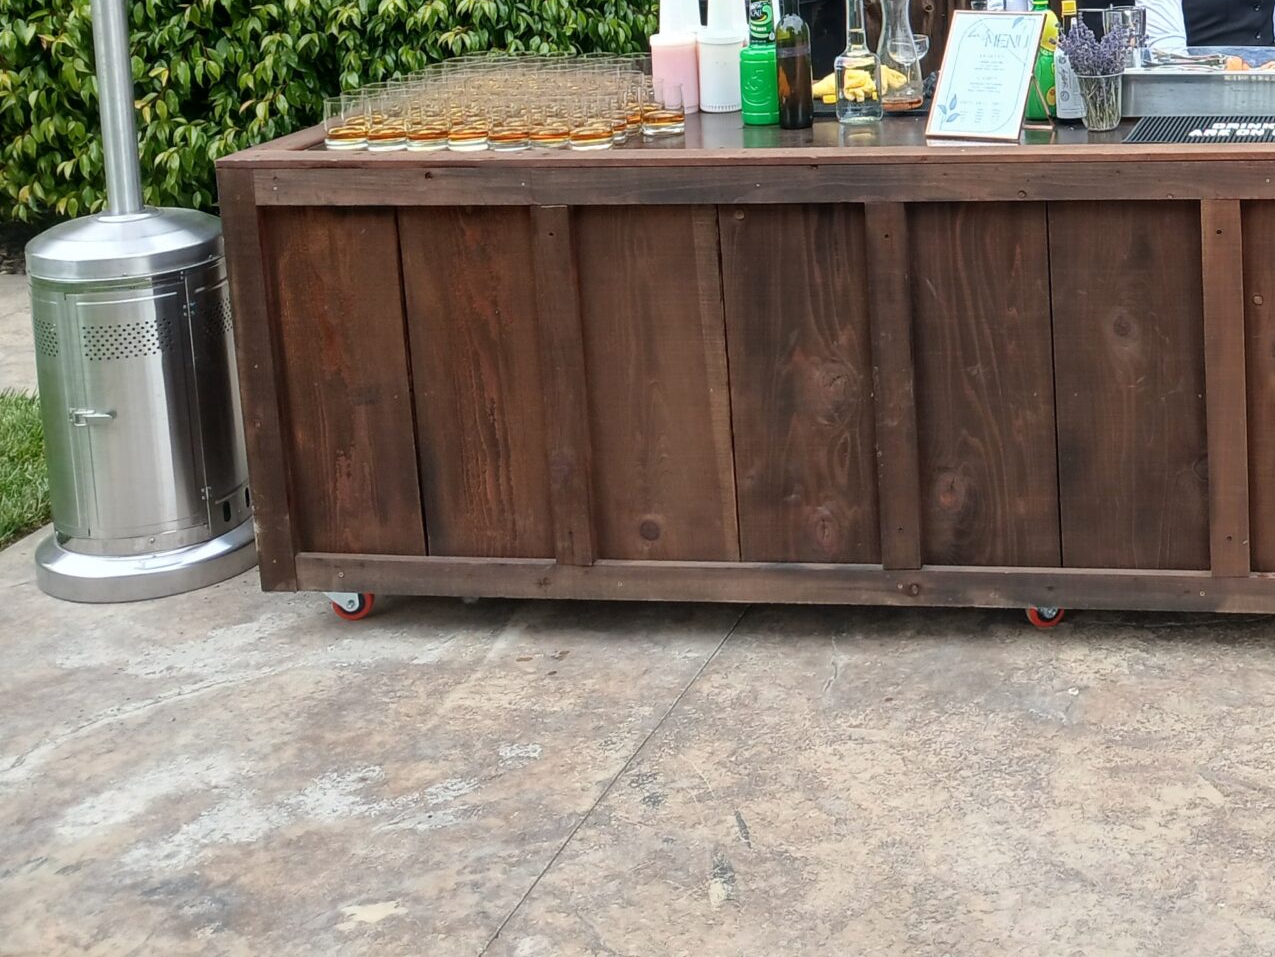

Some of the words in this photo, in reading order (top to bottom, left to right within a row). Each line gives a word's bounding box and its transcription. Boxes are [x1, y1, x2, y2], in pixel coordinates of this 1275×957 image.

[984, 33, 1030, 48] MENU
[1188, 129, 1231, 137] ARE
[1235, 129, 1265, 137] ON
